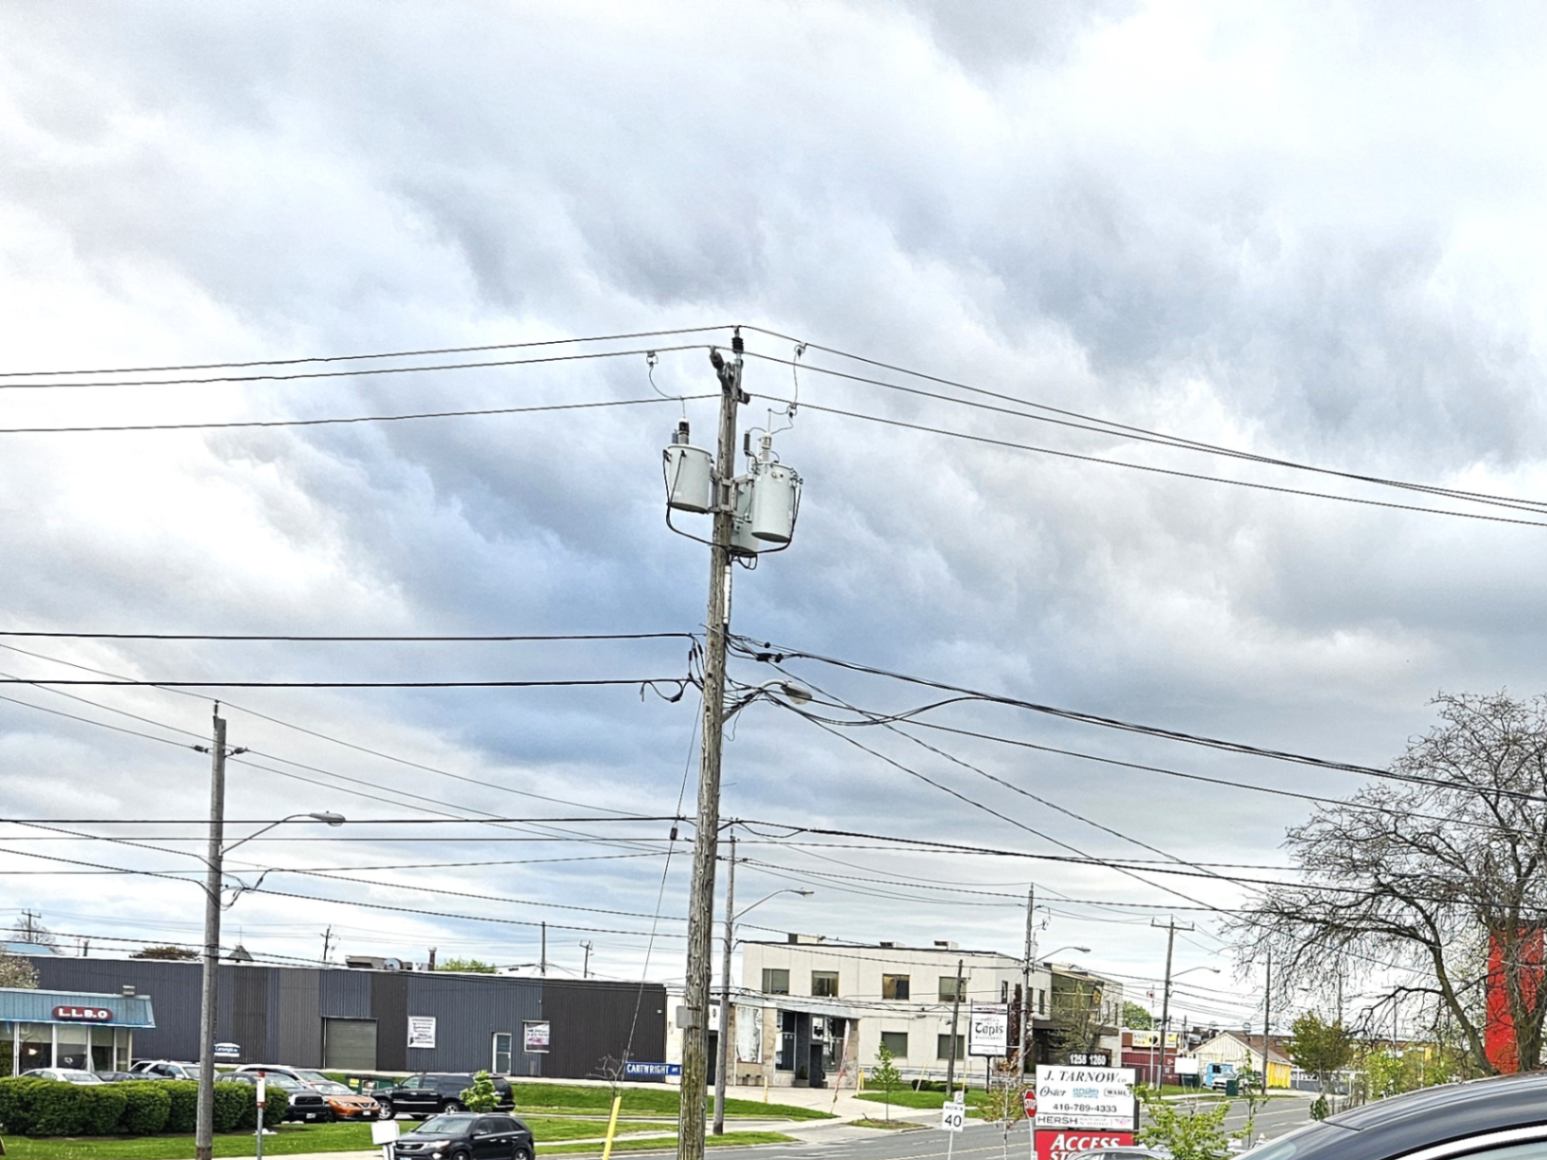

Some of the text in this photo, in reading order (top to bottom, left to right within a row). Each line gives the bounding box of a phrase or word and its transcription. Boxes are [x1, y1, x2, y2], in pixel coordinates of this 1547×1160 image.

[1069, 1053, 1107, 1066] 1258 1260
[626, 1063, 669, 1075] CARTWRIGHT
[1044, 1069, 1055, 1081] J.
[1059, 1070, 1119, 1083] TARNOW
[1052, 1103, 1118, 1113] 416-789-4333
[944, 1114, 962, 1128] 40
[1037, 1115, 1078, 1125] HERSH
